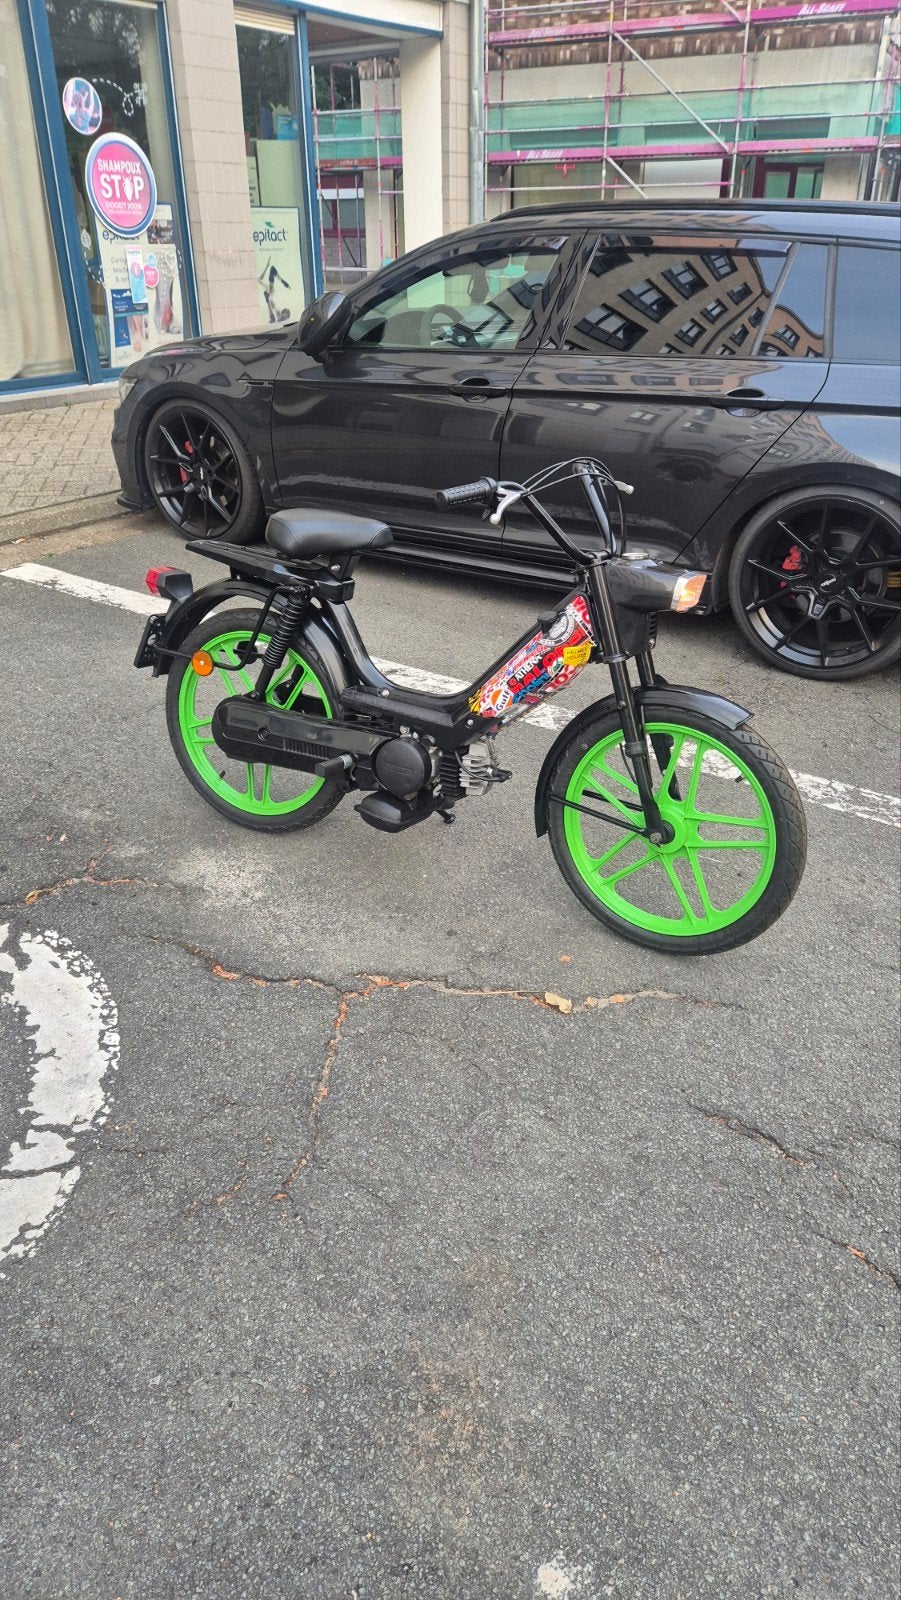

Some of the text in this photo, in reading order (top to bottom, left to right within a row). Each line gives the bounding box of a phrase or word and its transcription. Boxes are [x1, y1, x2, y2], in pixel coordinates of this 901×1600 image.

[97, 158, 142, 175] SHAMPOUX
[253, 228, 287, 246] epitact
[515, 655, 543, 683] ATHENA
[495, 689, 511, 711] Gulf
